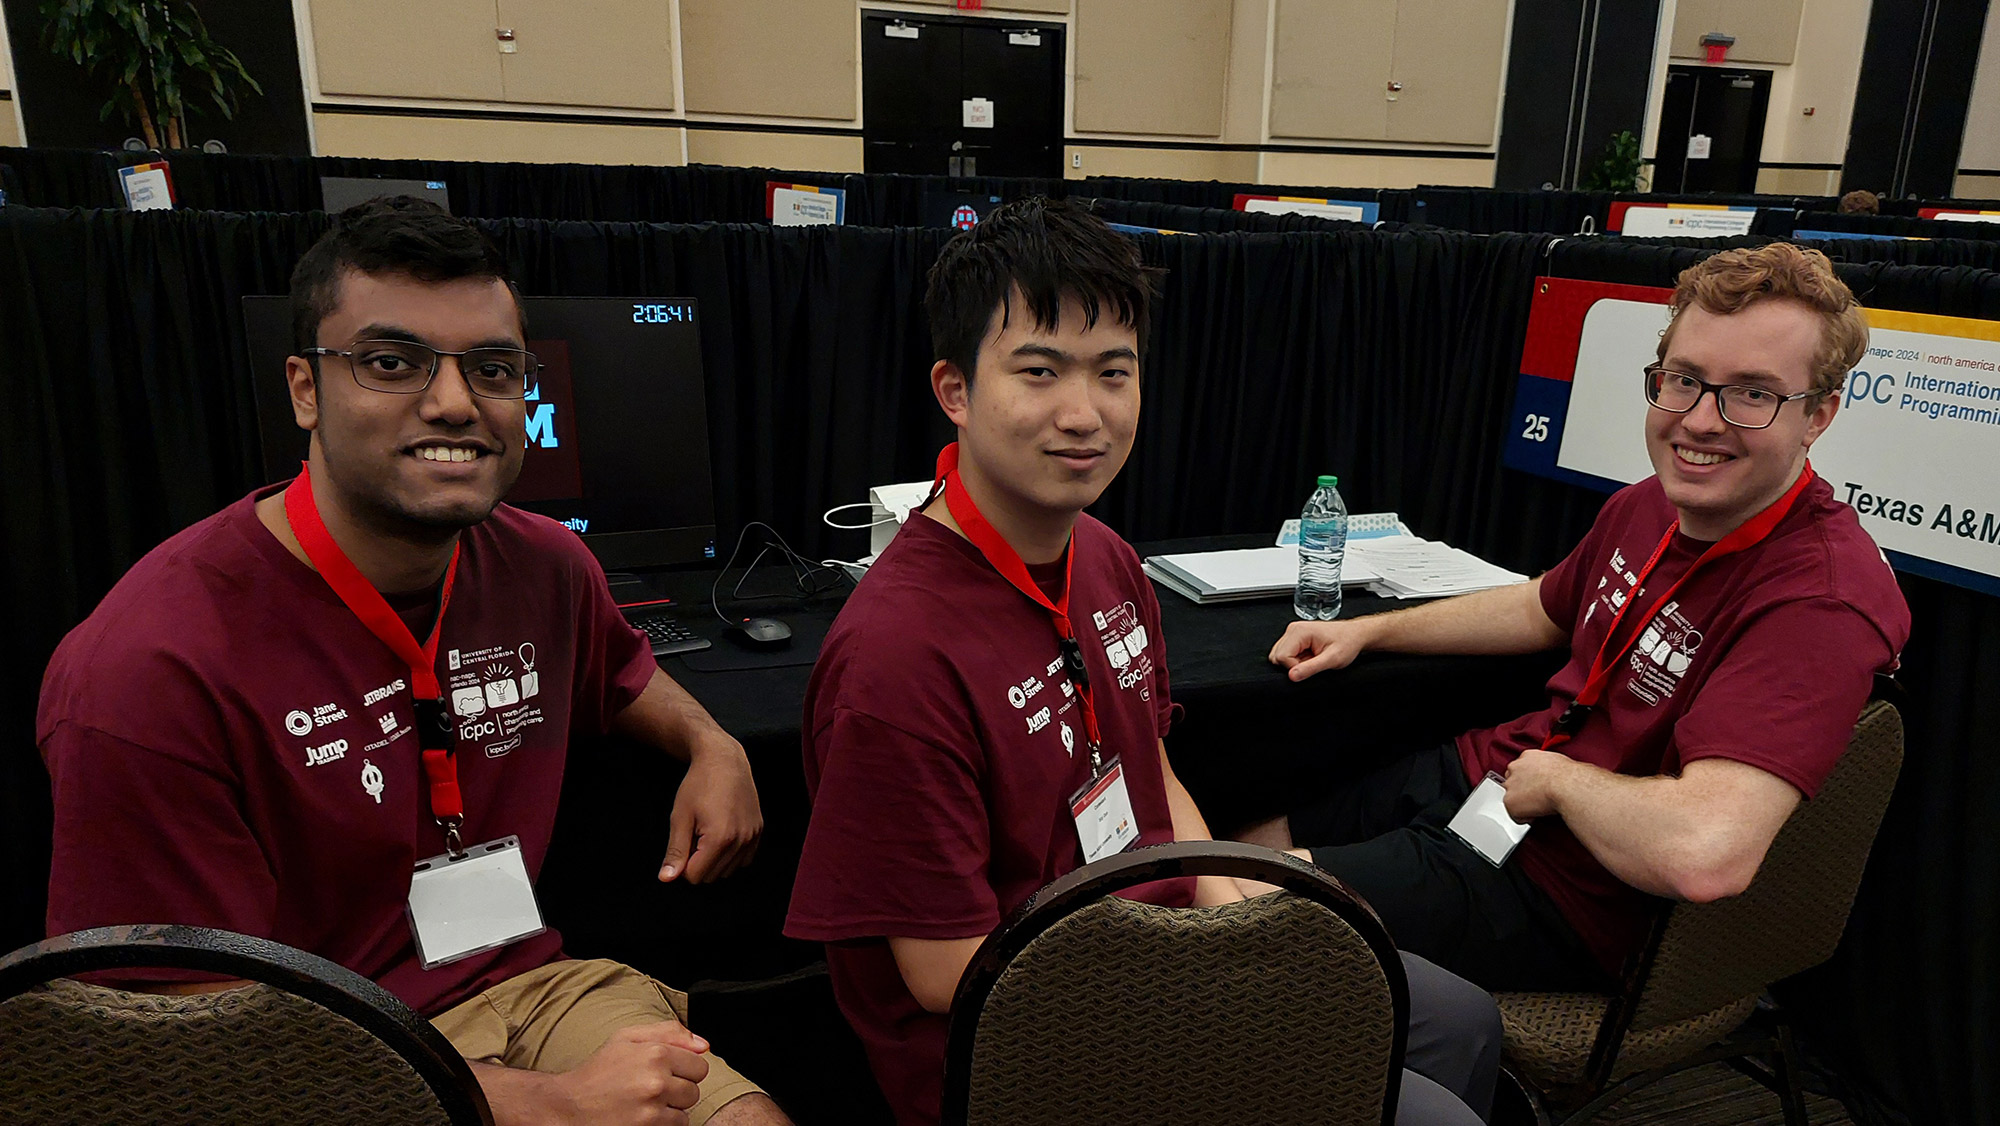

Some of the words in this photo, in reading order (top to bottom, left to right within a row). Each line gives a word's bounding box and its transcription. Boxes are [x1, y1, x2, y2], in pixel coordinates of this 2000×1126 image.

[632, 304, 693, 323] 2:06:41
[1866, 346, 1893, 360] -napc
[1895, 349, 1920, 361] 2024
[1927, 354, 1953, 366] north
[1954, 359, 1995, 372] america
[1840, 369, 1895, 409] pc
[1899, 394, 2000, 426] Programmi
[1522, 413, 1550, 442] 25
[559, 517, 588, 533] sity
[1844, 482, 1924, 526] Texas
[1930, 503, 2000, 546] A&M
[461, 648, 492, 659] UNIVERSITY
[462, 655, 488, 665] CENTRAL
[488, 650, 515, 660] FLORIDA
[1021, 676, 1037, 691] Jane
[1024, 680, 1045, 699] Street
[1117, 668, 1143, 690] icpc
[363, 679, 406, 706] JETBRANS
[312, 702, 337, 717] Jane
[314, 708, 348, 727] Street
[526, 716, 544, 725] camp
[1025, 706, 1051, 735] Jump
[459, 720, 496, 742] icpc
[305, 739, 349, 767] Jump
